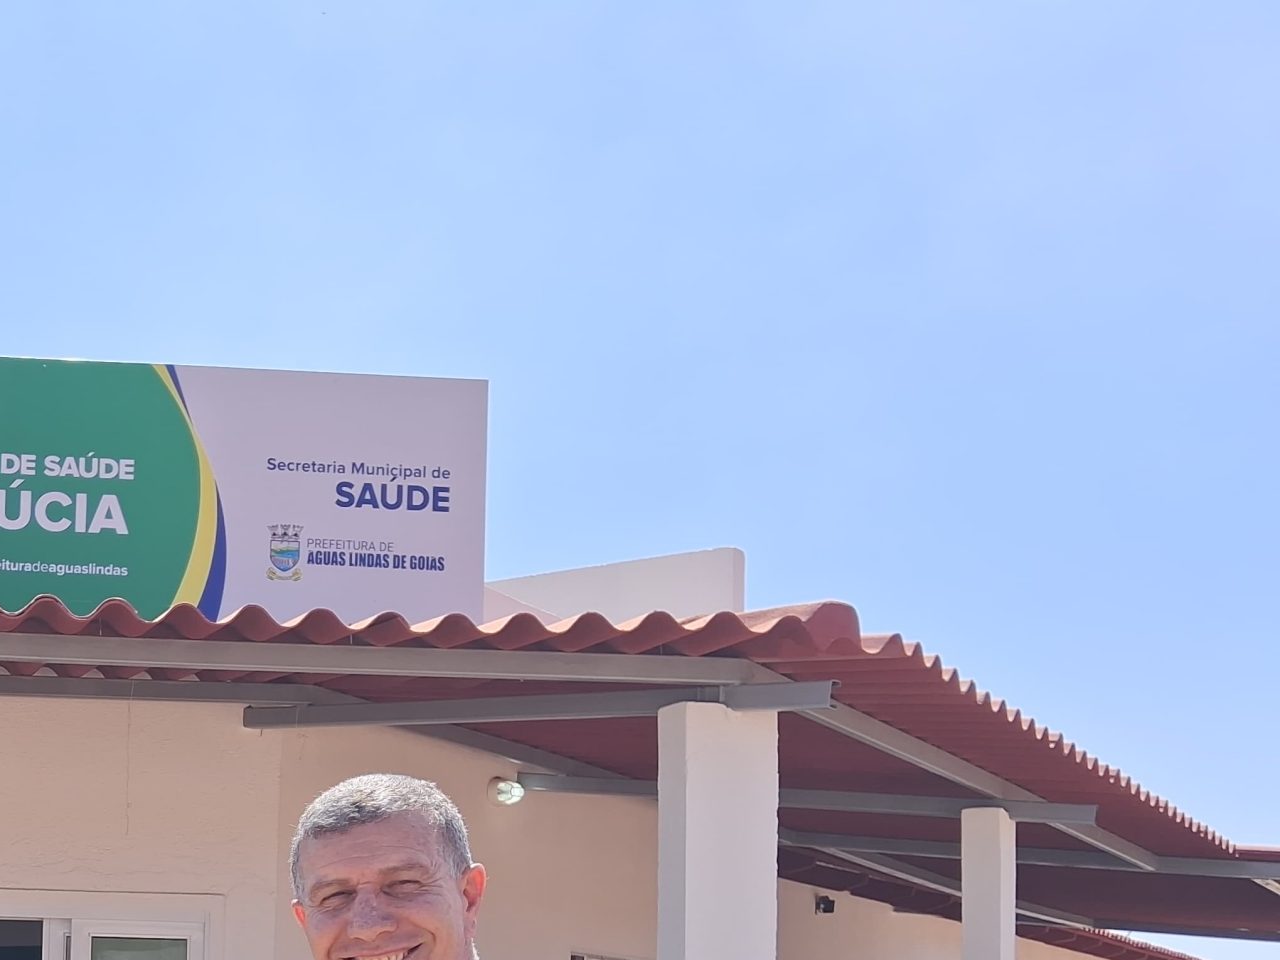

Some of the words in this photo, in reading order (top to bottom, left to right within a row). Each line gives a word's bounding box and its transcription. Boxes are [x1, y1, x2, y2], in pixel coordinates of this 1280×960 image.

[0, 453, 37, 475] DE
[43, 452, 135, 480] SAÚDE
[266, 457, 346, 475] Secretaria
[351, 462, 427, 481] Municipal
[431, 466, 451, 480] de
[334, 476, 451, 513] SAÚDE
[306, 537, 376, 551] PREFEITURA
[379, 541, 395, 553] DE
[348, 552, 391, 570] LINDAS
[392, 554, 407, 570] DE
